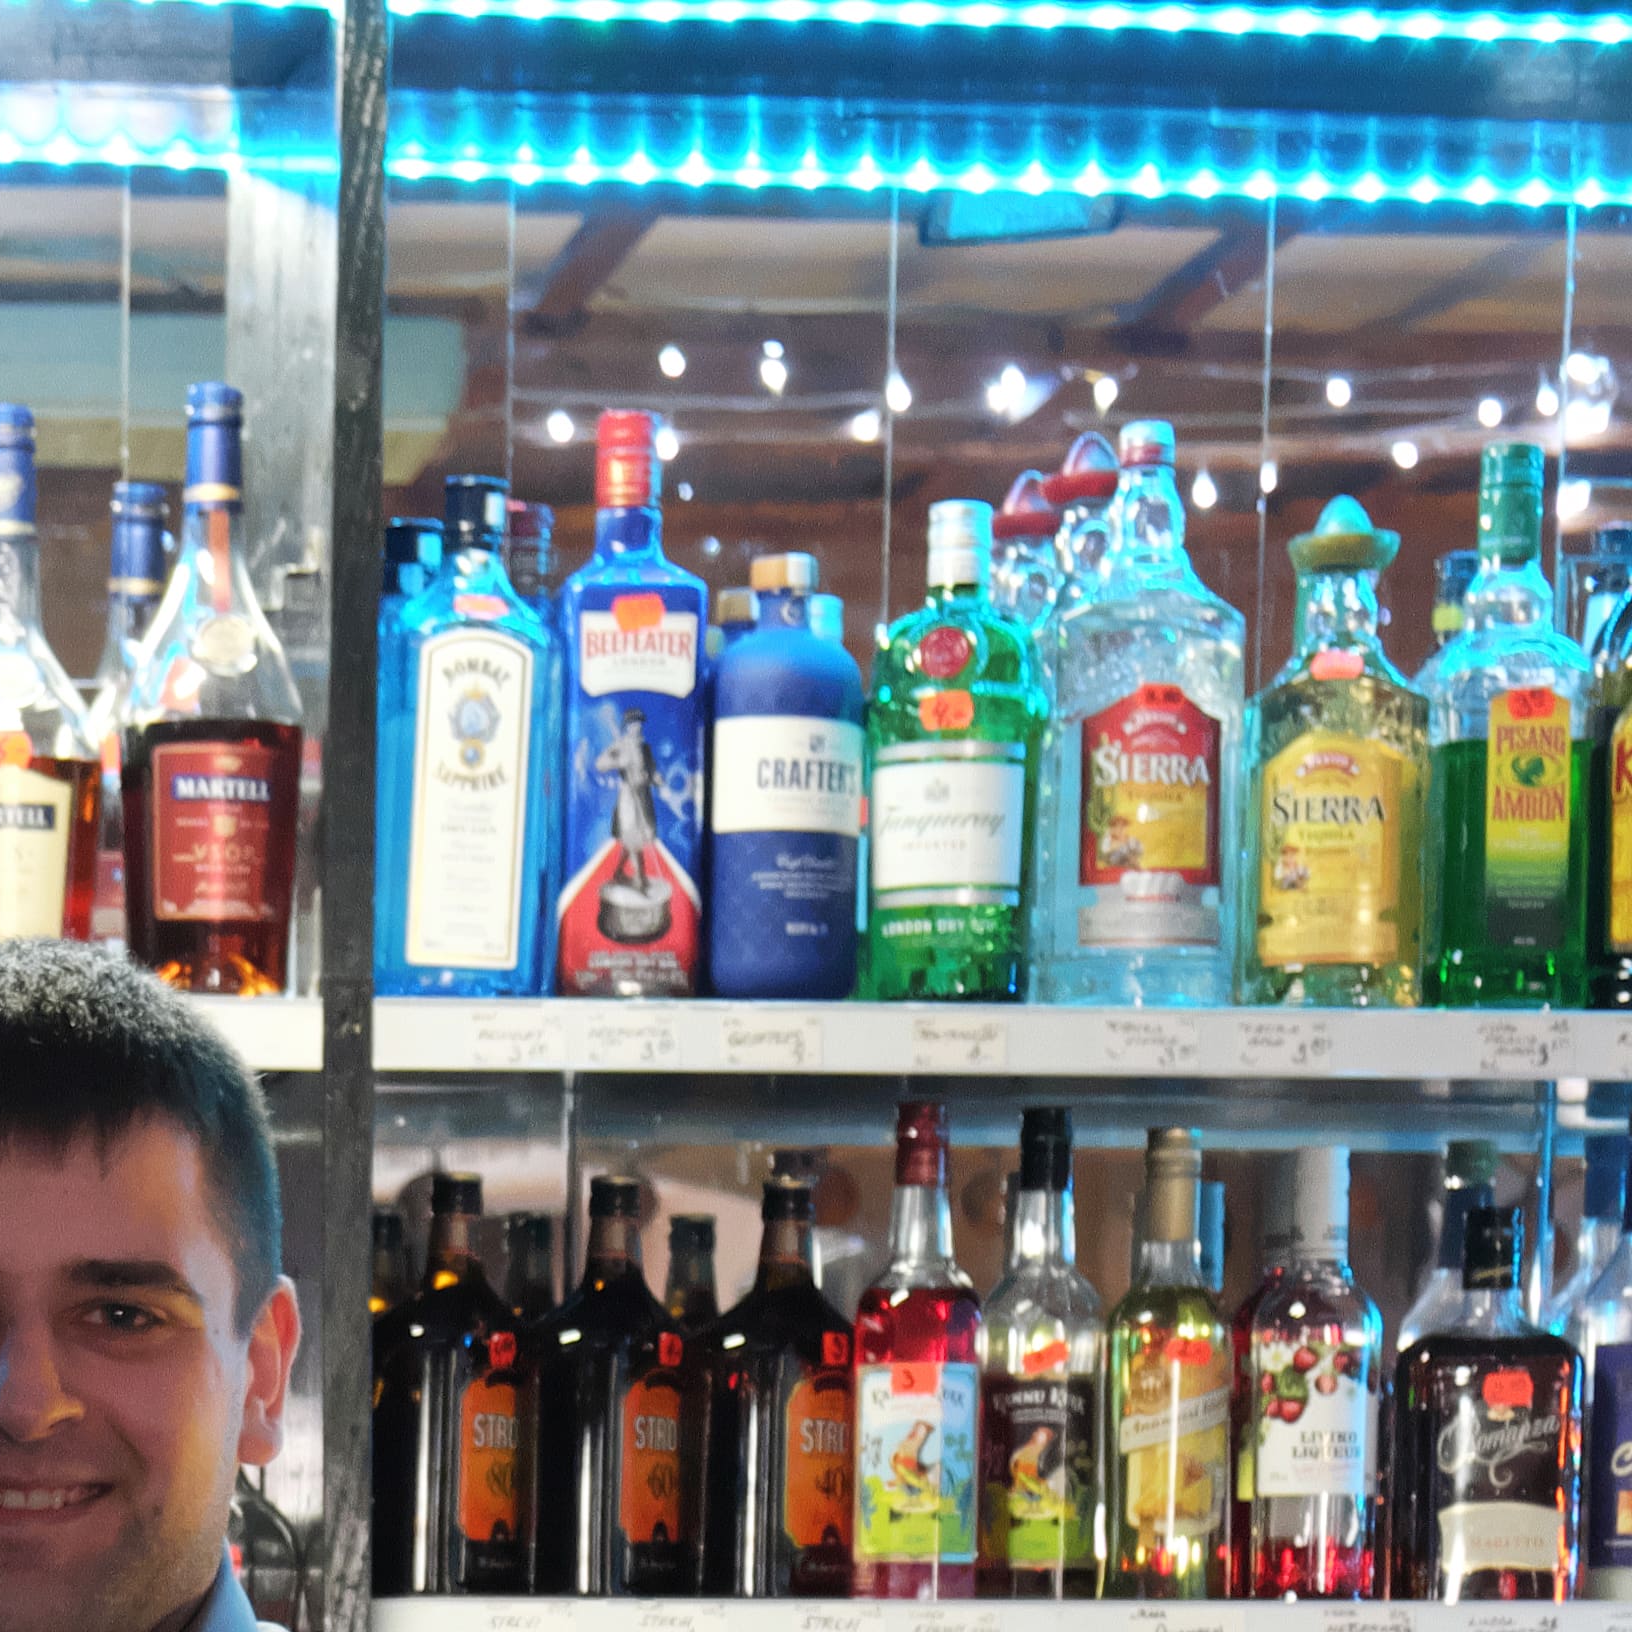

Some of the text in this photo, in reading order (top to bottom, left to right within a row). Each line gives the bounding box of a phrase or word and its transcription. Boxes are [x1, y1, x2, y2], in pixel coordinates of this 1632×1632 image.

[585, 630, 693, 661] BEEFEATER
[441, 656, 511, 687] BOMBAY
[1496, 725, 1566, 755] PISANG
[1095, 750, 1211, 785] SIERRA
[175, 778, 269, 800] MARTELL
[877, 808, 1006, 838] Tanqueray
[1273, 792, 1386, 825] SIERRA
[882, 919, 932, 938] LONDON
[935, 917, 965, 935] DRY
[473, 1413, 518, 1449] STRO
[634, 1415, 679, 1451] STRO
[801, 1418, 848, 1453] STRO
[1300, 1431, 1358, 1444] LIVIKO
